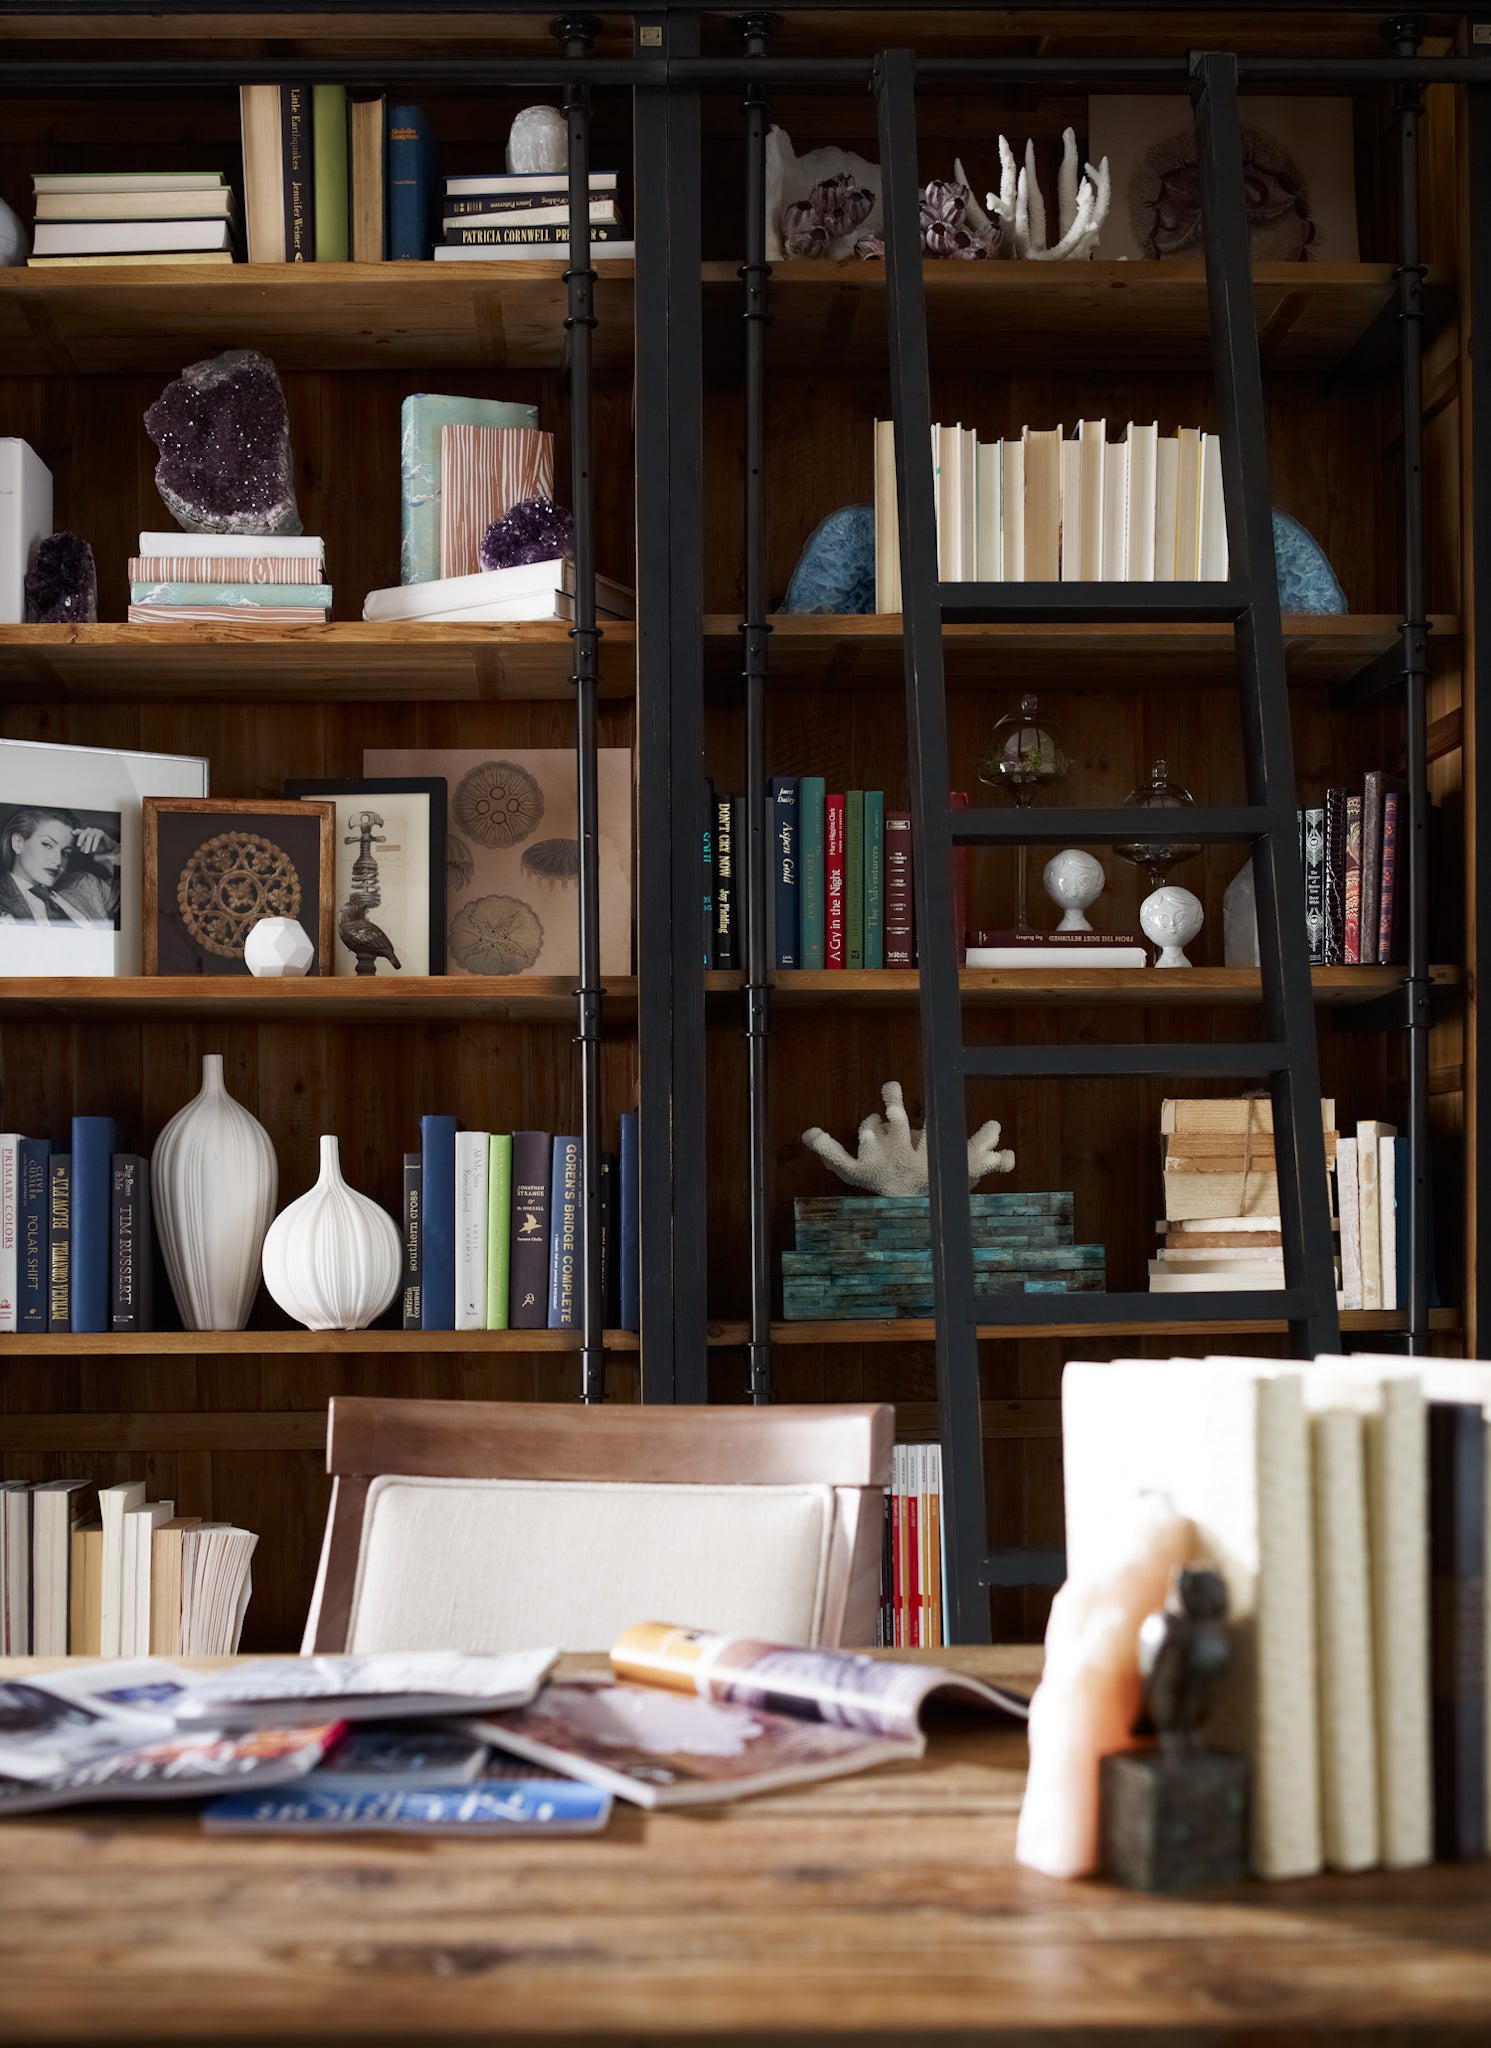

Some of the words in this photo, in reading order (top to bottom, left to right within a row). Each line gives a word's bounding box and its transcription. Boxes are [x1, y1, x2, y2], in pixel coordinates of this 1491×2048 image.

[290, 89, 300, 113] Little
[290, 115, 302, 171] Earthquakes
[292, 181, 302, 217] Jennifer
[490, 201, 514, 210] Patterson
[514, 198, 533, 208] James
[294, 217, 303, 249] Weiner
[462, 229, 500, 244] PATRICIA
[504, 228, 550, 243] CORNWELL
[718, 802, 730, 834] DON'T
[718, 834, 730, 854] CRY
[779, 821, 794, 855] Aspen
[718, 856, 731, 878] NOW
[783, 858, 794, 885] Gold
[830, 869, 842, 896] Night
[868, 845, 878, 906] Adventurers
[718, 888, 730, 902] Joy
[830, 898, 840, 916] the
[718, 903, 730, 934] Fielding
[830, 919, 840, 930] in
[868, 907, 878, 928] The
[830, 933, 842, 951] Cry
[830, 951, 840, 961] A
[4, 1148, 13, 1205] PRIMARY
[124, 1164, 134, 1179] Big
[474, 1160, 482, 1171] My
[564, 1144, 577, 1200] GOREN'S
[52, 1176, 69, 1198] FLY
[125, 1179, 134, 1196] Russ
[462, 1170, 471, 1213] Remembered
[52, 1198, 69, 1230] BLOW
[120, 1204, 132, 1235] TIM
[410, 1190, 418, 1220] cross
[4, 1205, 14, 1249] COLORS
[27, 1215, 38, 1254] POLAR
[562, 1204, 576, 1251] BRIDGE
[52, 1240, 68, 1284] CORNWELL
[408, 1221, 418, 1272] southern
[28, 1258, 38, 1290] SHIFT
[120, 1238, 132, 1305] RUSSERT
[52, 1284, 68, 1321] PATRICIA
[404, 1286, 412, 1318] patricia
[412, 1286, 420, 1318] cornwell
[560, 1255, 574, 1323] COMPLETE
